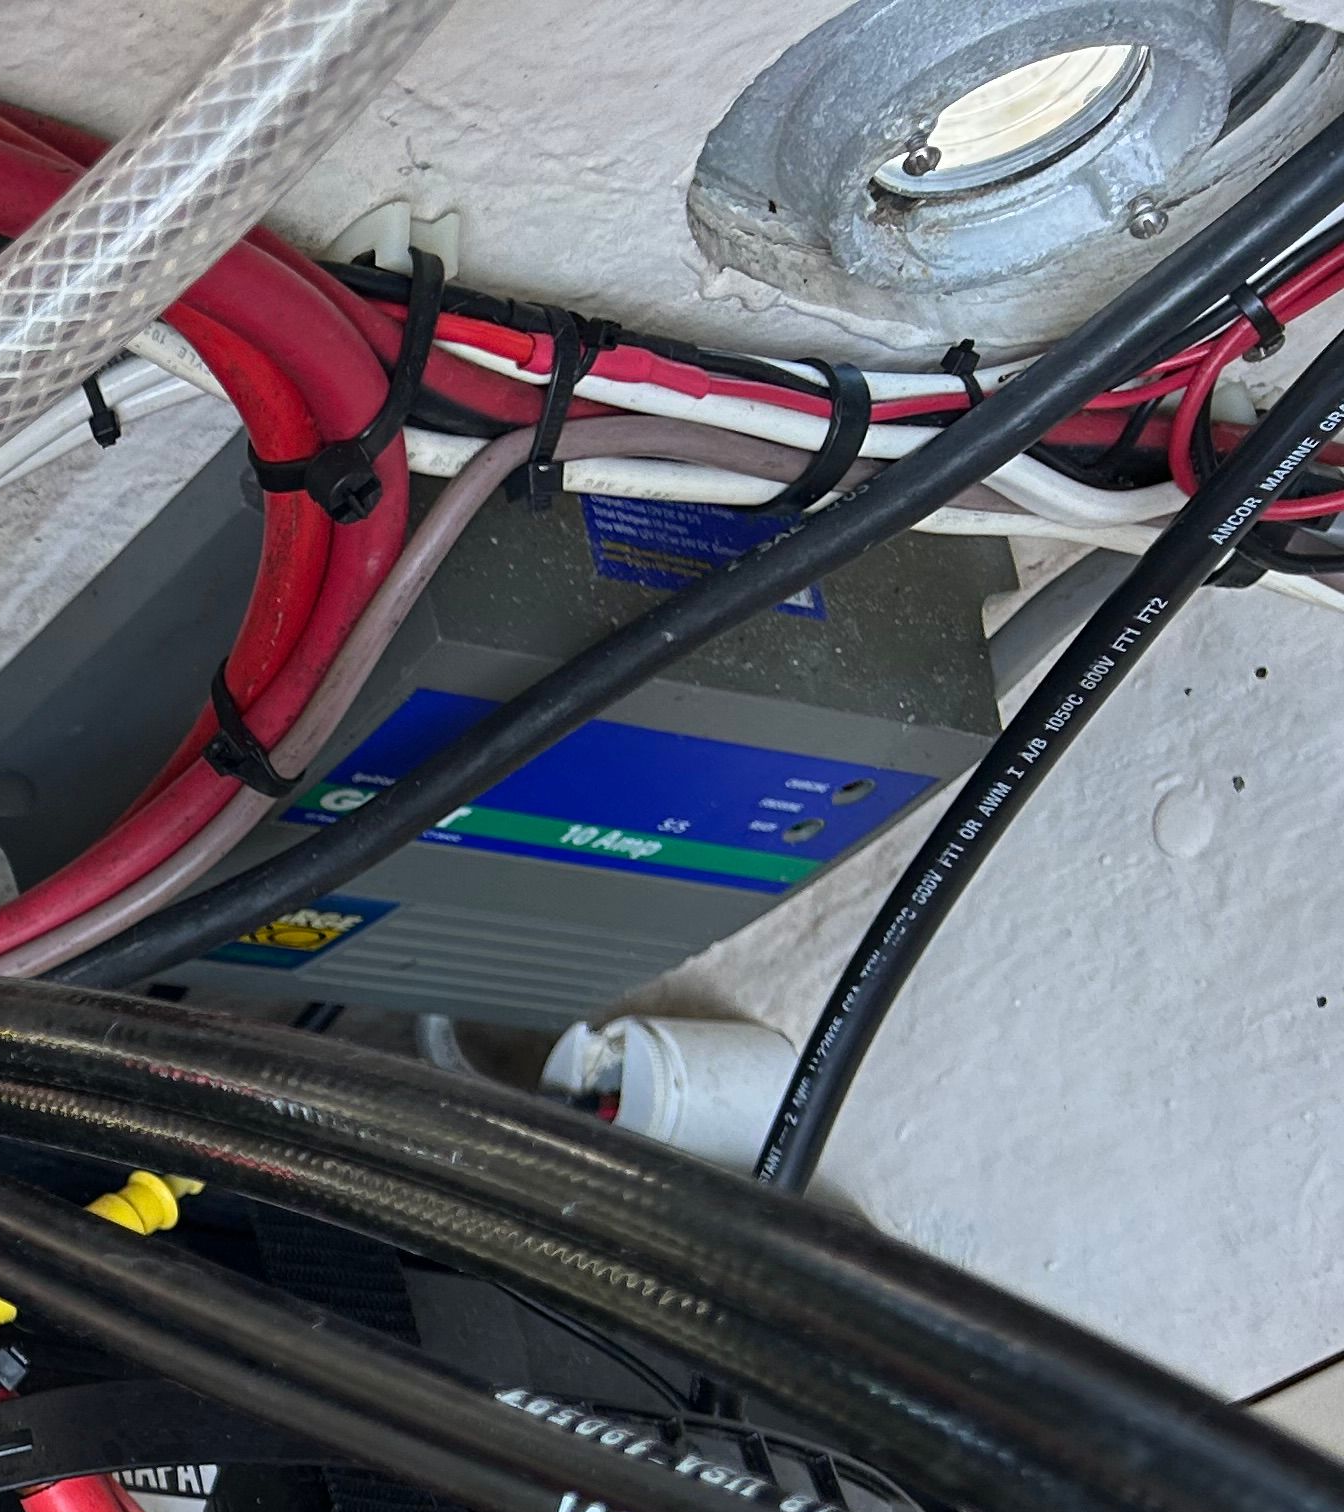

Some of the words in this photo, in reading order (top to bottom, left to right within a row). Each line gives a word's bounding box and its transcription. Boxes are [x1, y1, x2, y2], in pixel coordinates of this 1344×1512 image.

[959, 819, 983, 841] OR
[978, 781, 1012, 818] AWM
[1019, 737, 1048, 764] A/B
[1080, 655, 1116, 691] 600V
[1111, 627, 1141, 653] FT1
[1135, 596, 1169, 624] FT2
[1209, 496, 1263, 546] ANCOR
[1259, 436, 1320, 492] MARINE
[560, 824, 599, 846] 10
[592, 830, 662, 859] Amp
[675, 1453, 773, 1499] USA
